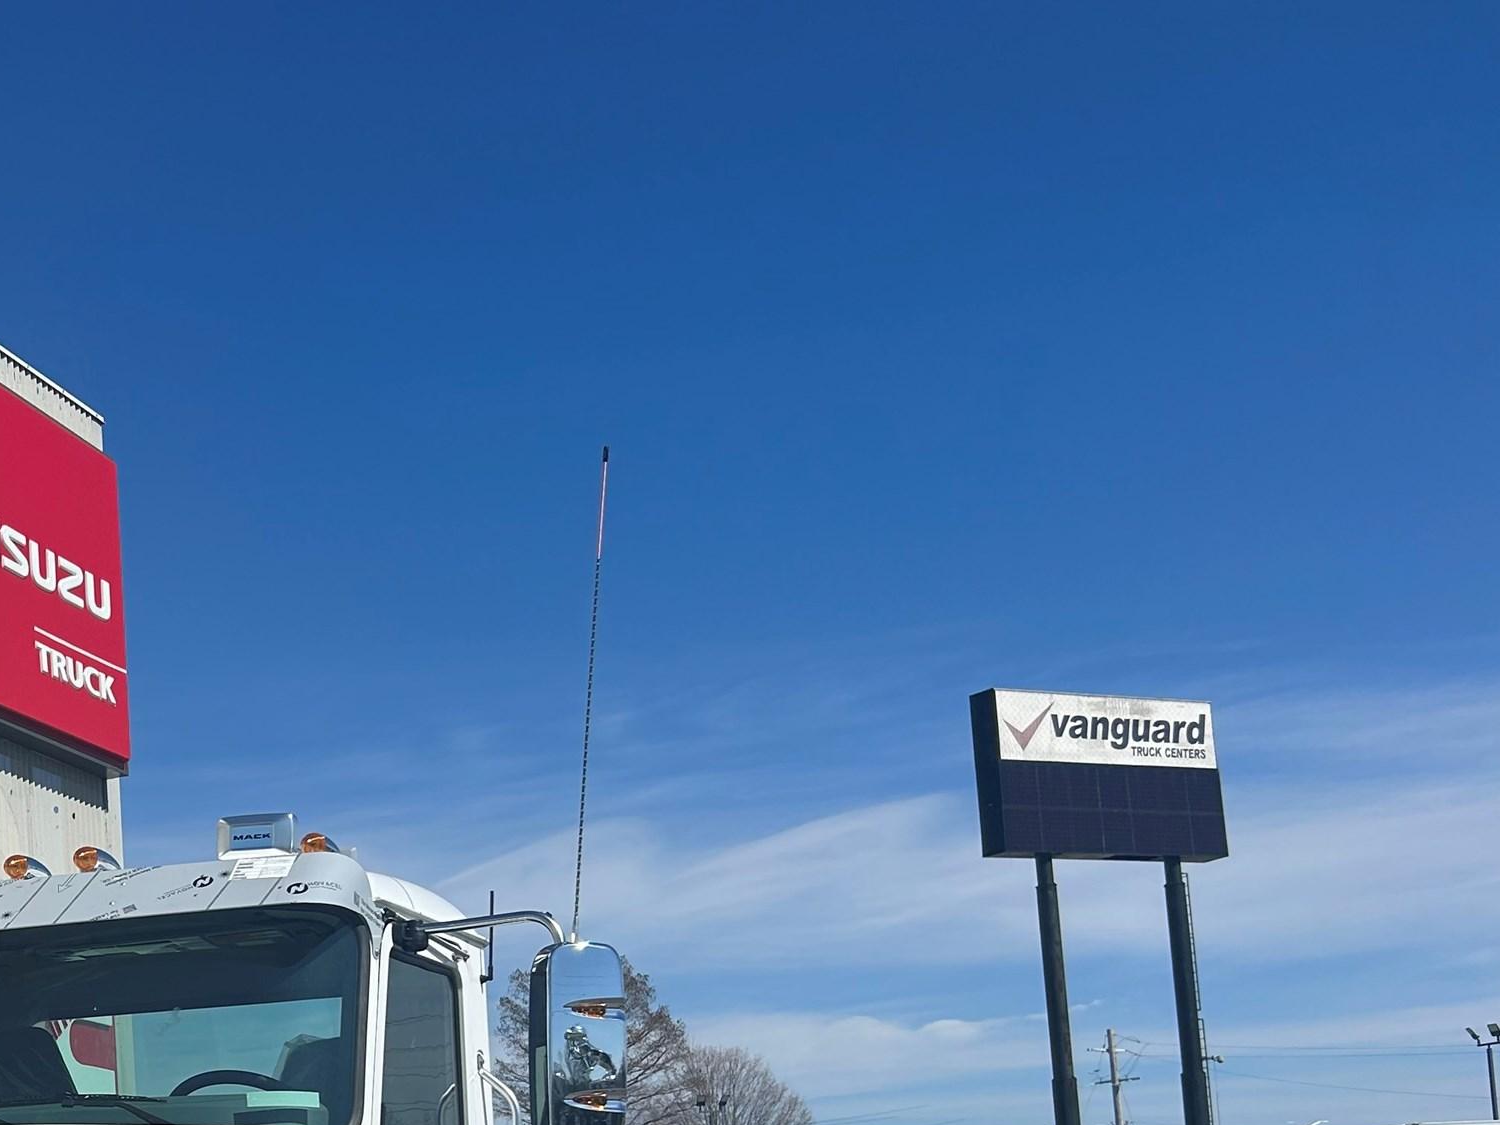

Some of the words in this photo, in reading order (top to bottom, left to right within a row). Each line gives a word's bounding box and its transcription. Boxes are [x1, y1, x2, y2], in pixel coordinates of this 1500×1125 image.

[34, 639, 117, 706] TRUCK
[1050, 713, 1206, 750] vanguard
[1131, 746, 1162, 758] TRUCK
[1164, 747, 1206, 759] CENTERS
[232, 832, 272, 841] MACK
